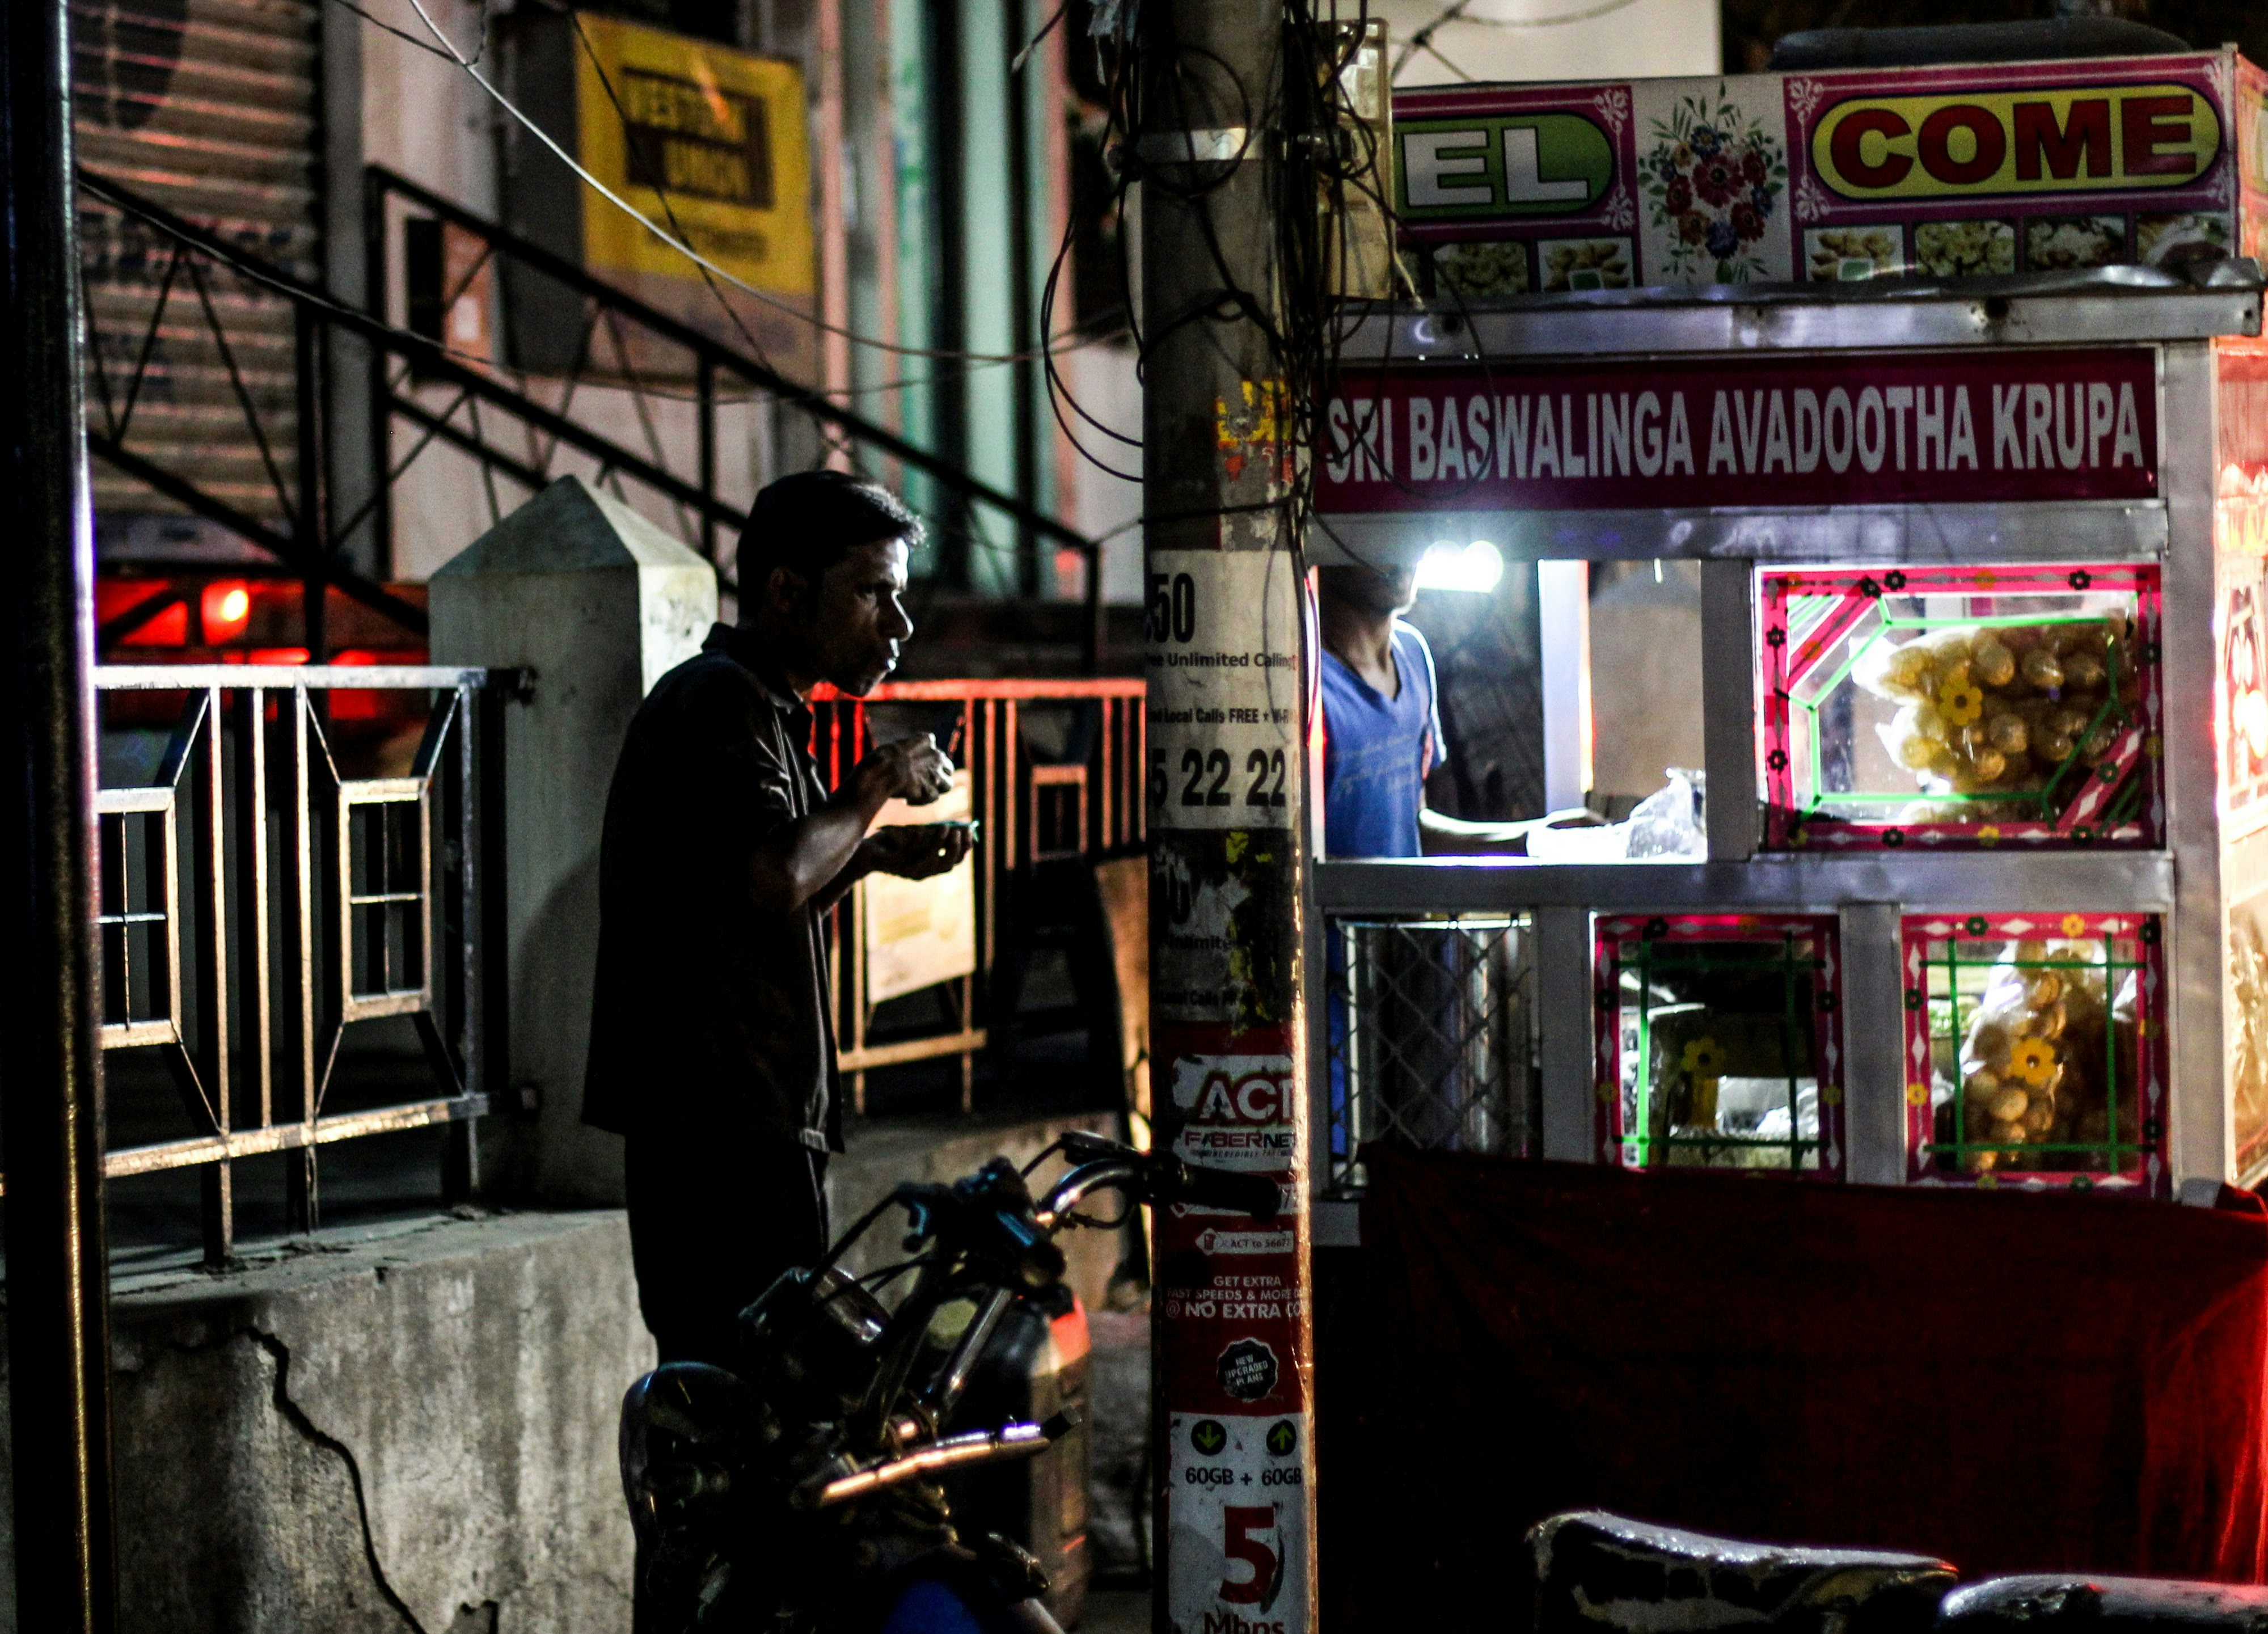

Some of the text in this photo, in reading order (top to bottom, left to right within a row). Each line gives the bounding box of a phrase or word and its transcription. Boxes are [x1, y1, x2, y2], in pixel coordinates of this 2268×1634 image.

[1403, 95, 2197, 207] EL COME
[1325, 381, 2145, 483] SRI BASWALINGA AVADOOTHA KRUPA
[1146, 573, 1195, 643] 50
[1168, 652, 1248, 667] Unlimited
[1165, 708, 1192, 723] Local
[1197, 708, 1225, 724] Calls
[1229, 708, 1259, 723] FREE
[1181, 748, 1231, 807] 22
[1247, 748, 1286, 807] 22
[1213, 1276, 1282, 1287] GET EXTRA
[1195, 1289, 1242, 1301] SPEEDS
[1247, 1290, 1256, 1301] &
[1260, 1289, 1291, 1300] MORE
[1185, 1301, 1217, 1319] NO
[1223, 1302, 1282, 1319] EXTRA
[1185, 1467, 1234, 1485] 60GB
[1261, 1467, 1302, 1485] 60GB
[1219, 1506, 1277, 1604] 5
